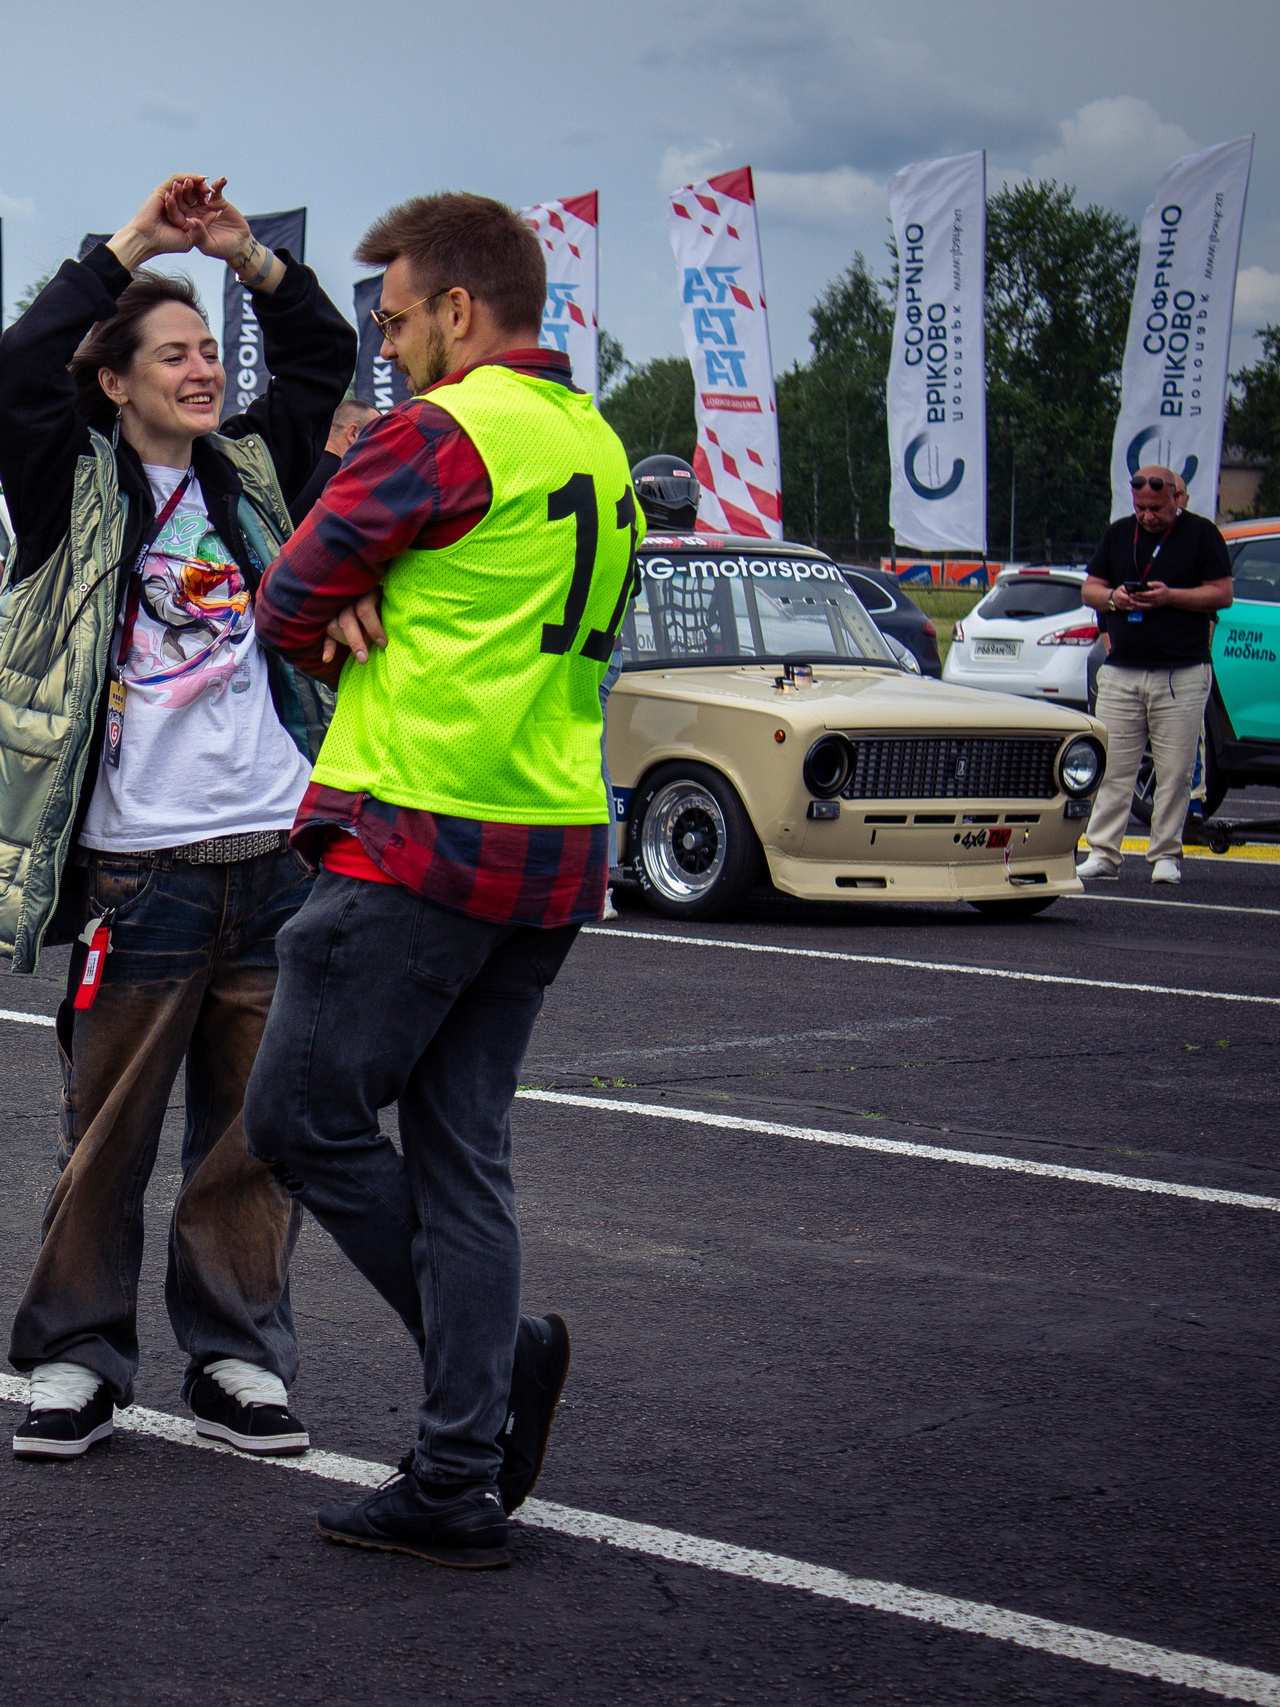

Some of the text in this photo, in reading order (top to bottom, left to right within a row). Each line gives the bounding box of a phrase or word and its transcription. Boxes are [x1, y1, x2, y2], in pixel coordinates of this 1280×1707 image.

[540, 472, 638, 664] 11
[1227, 629, 1263, 645] дели
[1223, 643, 1277, 662] мобиль
